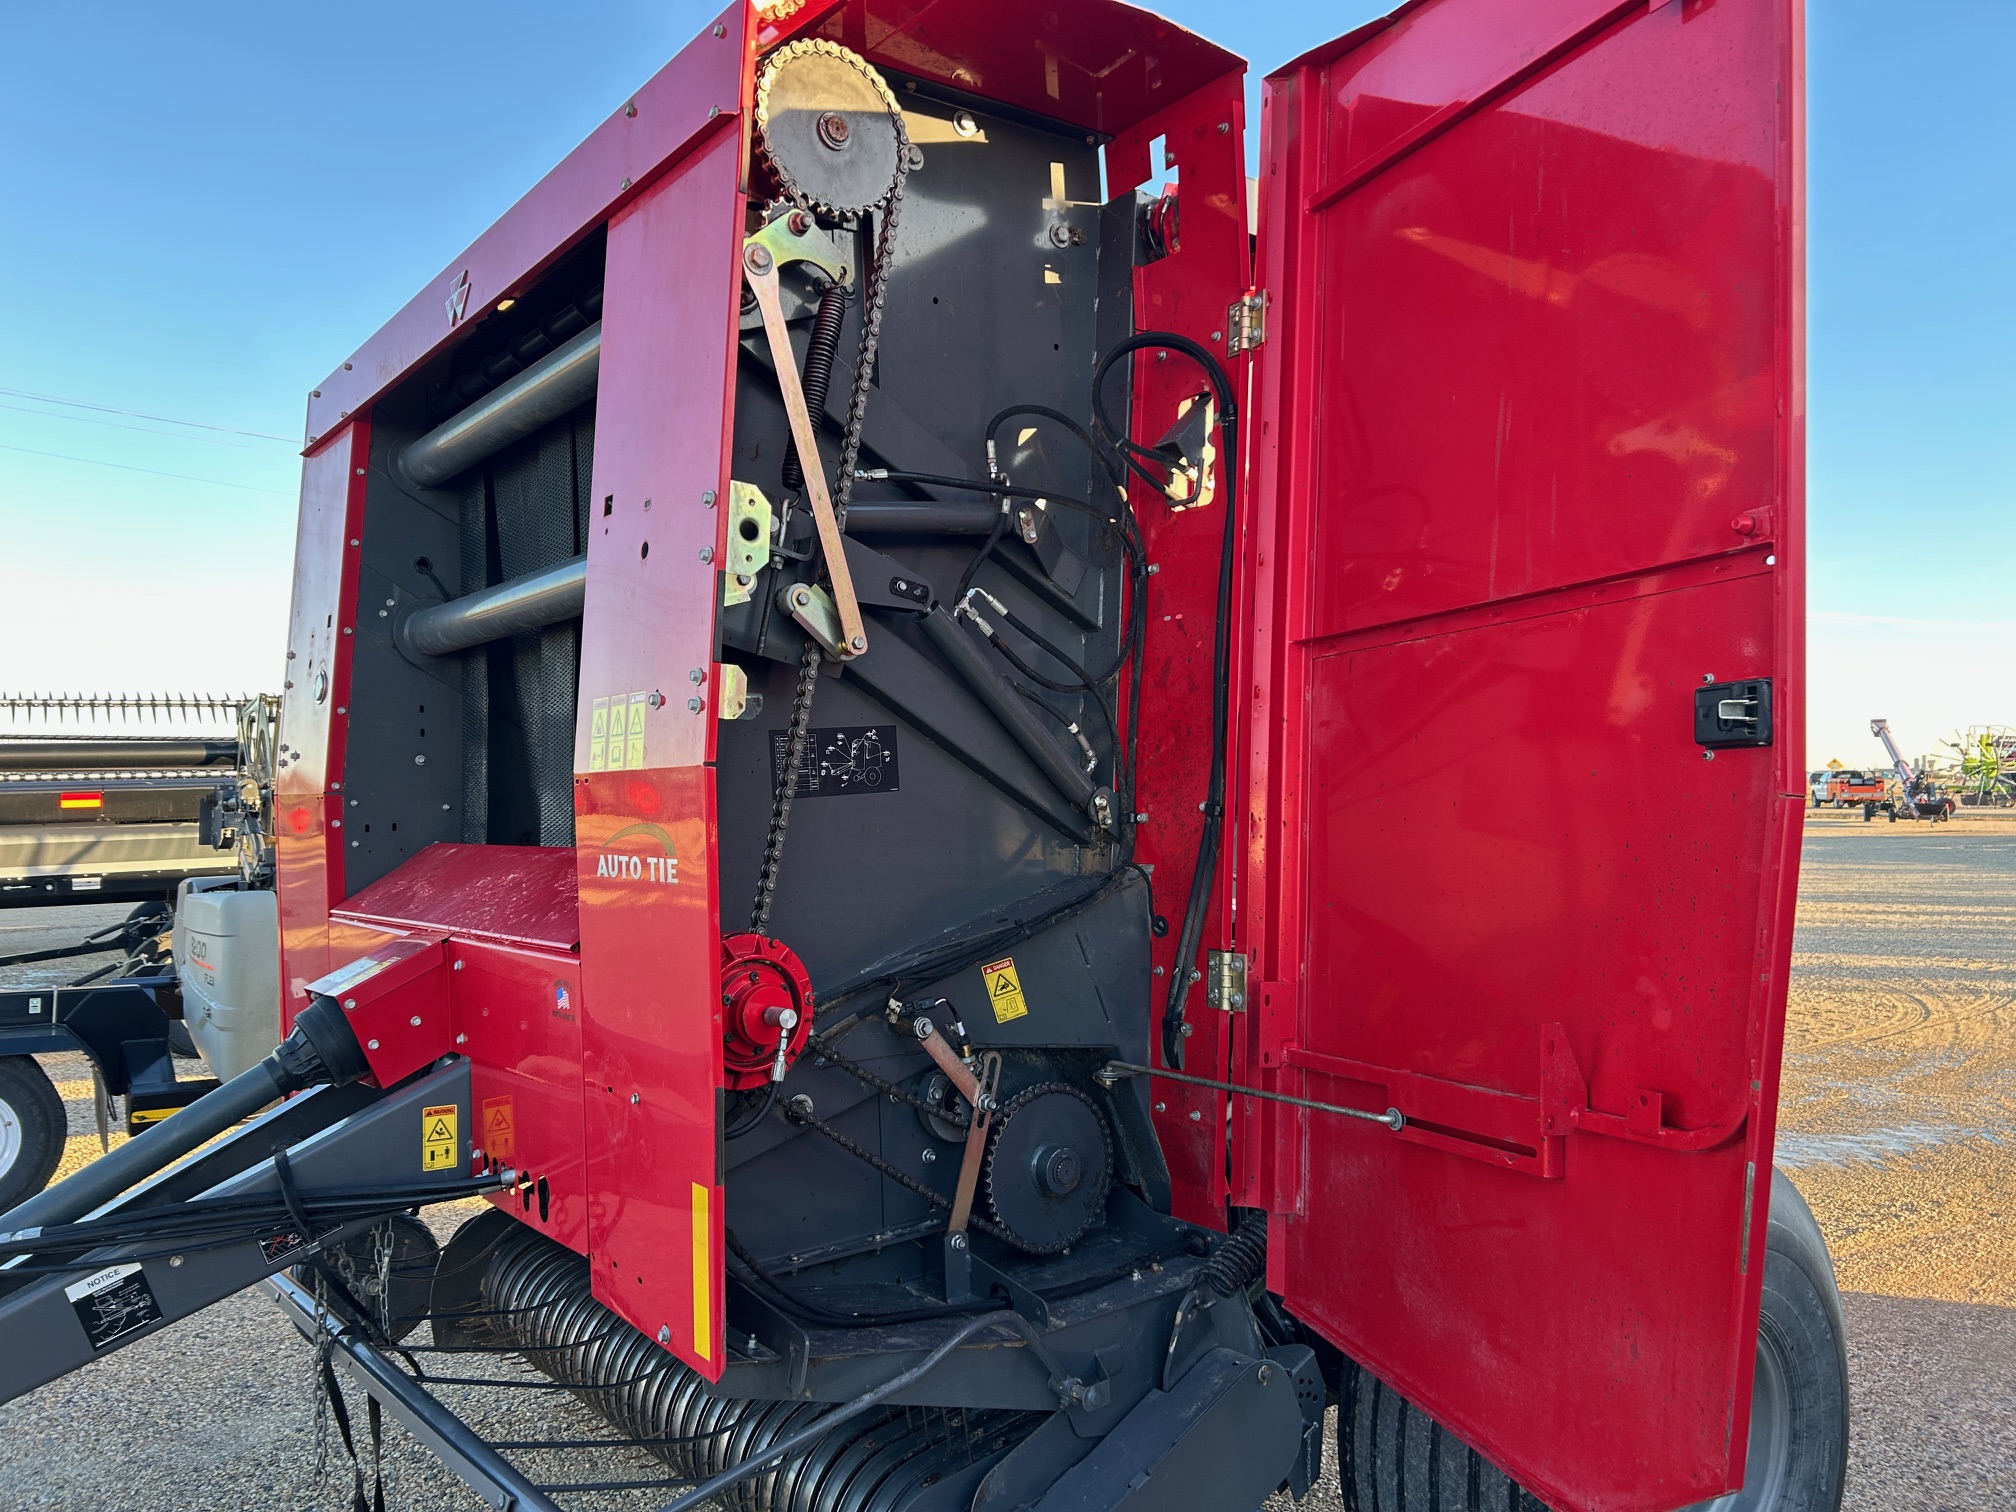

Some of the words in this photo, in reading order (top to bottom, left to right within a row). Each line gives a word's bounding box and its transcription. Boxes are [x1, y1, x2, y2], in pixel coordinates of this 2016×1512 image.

[596, 854, 642, 880] AUTO
[646, 857, 679, 884] TIE
[992, 961, 1011, 971] DANGER
[433, 1107, 454, 1115] WARNING
[86, 1268, 121, 1289] NOTICE
